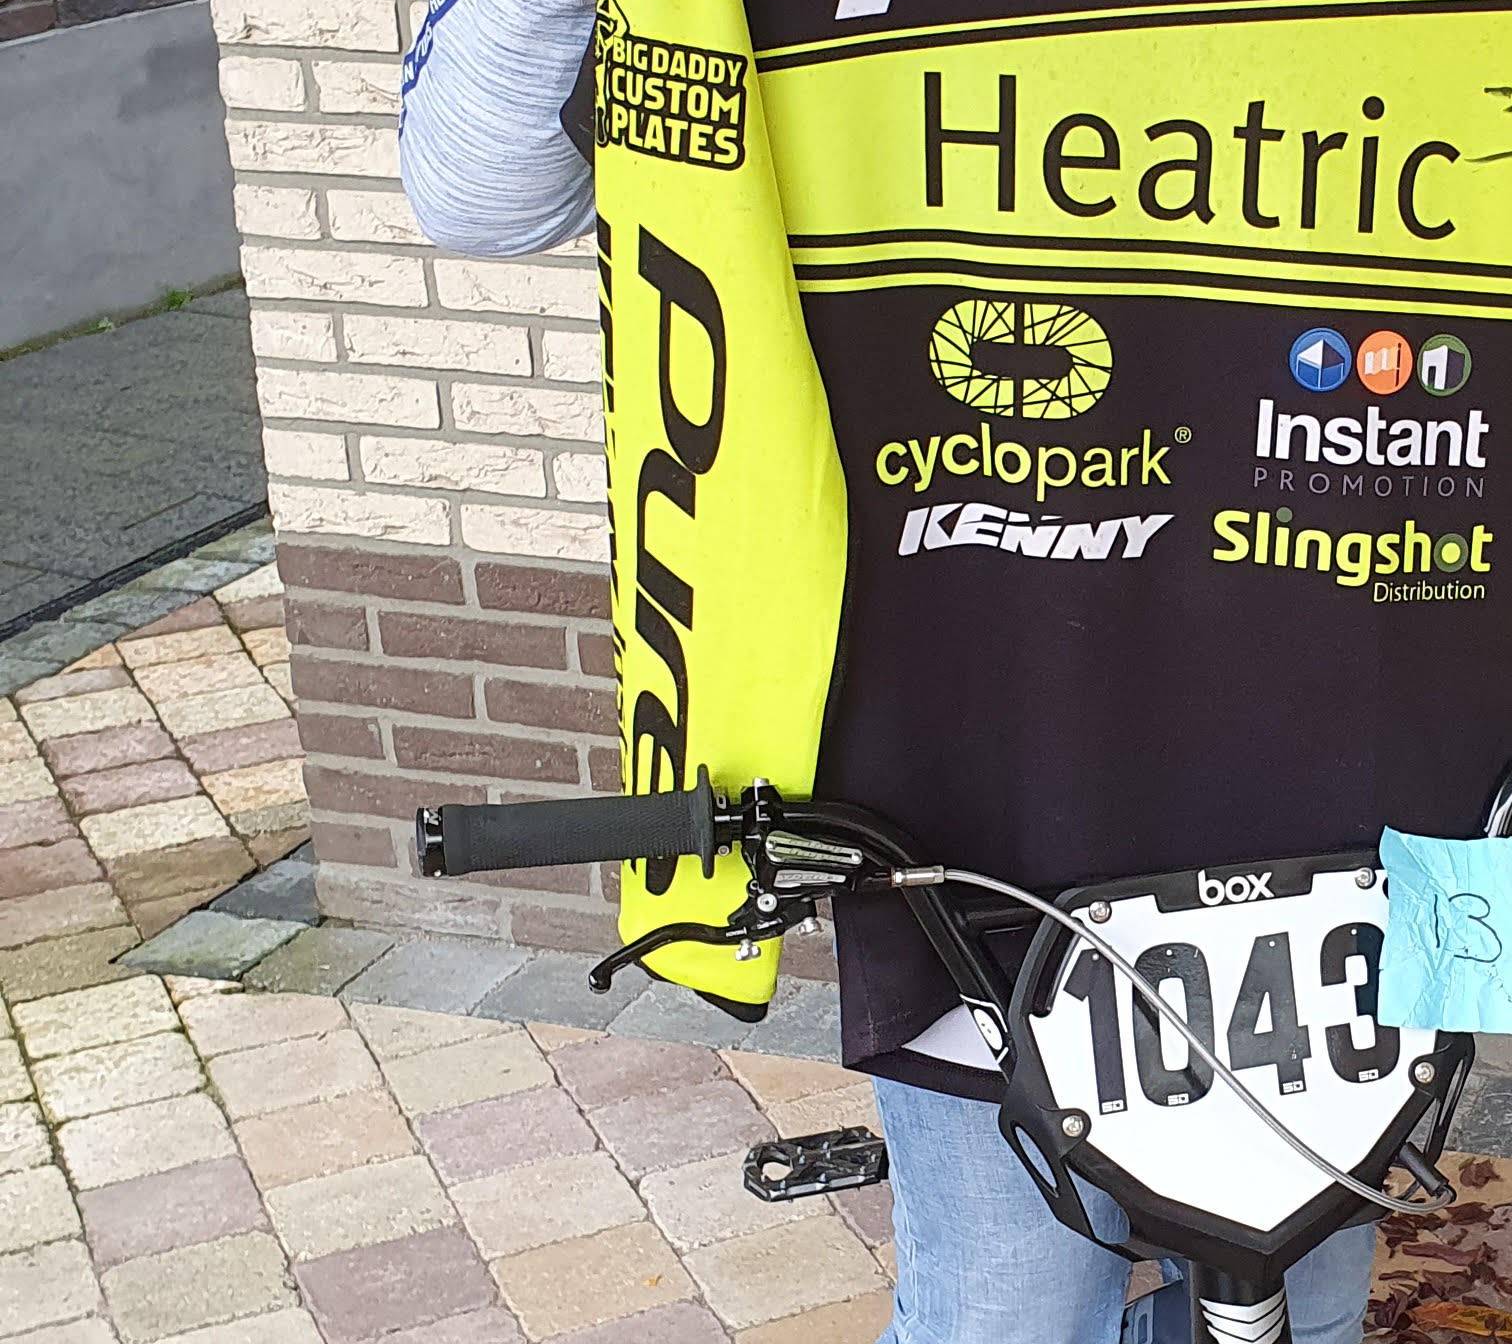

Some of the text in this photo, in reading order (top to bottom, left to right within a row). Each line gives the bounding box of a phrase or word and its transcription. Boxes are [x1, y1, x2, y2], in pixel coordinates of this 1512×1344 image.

[612, 35, 742, 87] BIG DADDY
[611, 67, 741, 125] CUSTOM
[611, 103, 739, 165] PLATES
[923, 70, 1463, 241] Heatric
[1256, 398, 1490, 468] Instant
[1253, 466, 1485, 498] PROMOTION
[898, 503, 1176, 560] KENNY
[1212, 506, 1494, 587] Slingshot
[1372, 579, 1486, 603] Distribution
[1198, 870, 1275, 906] box
[1063, 922, 1401, 1114] 1043
